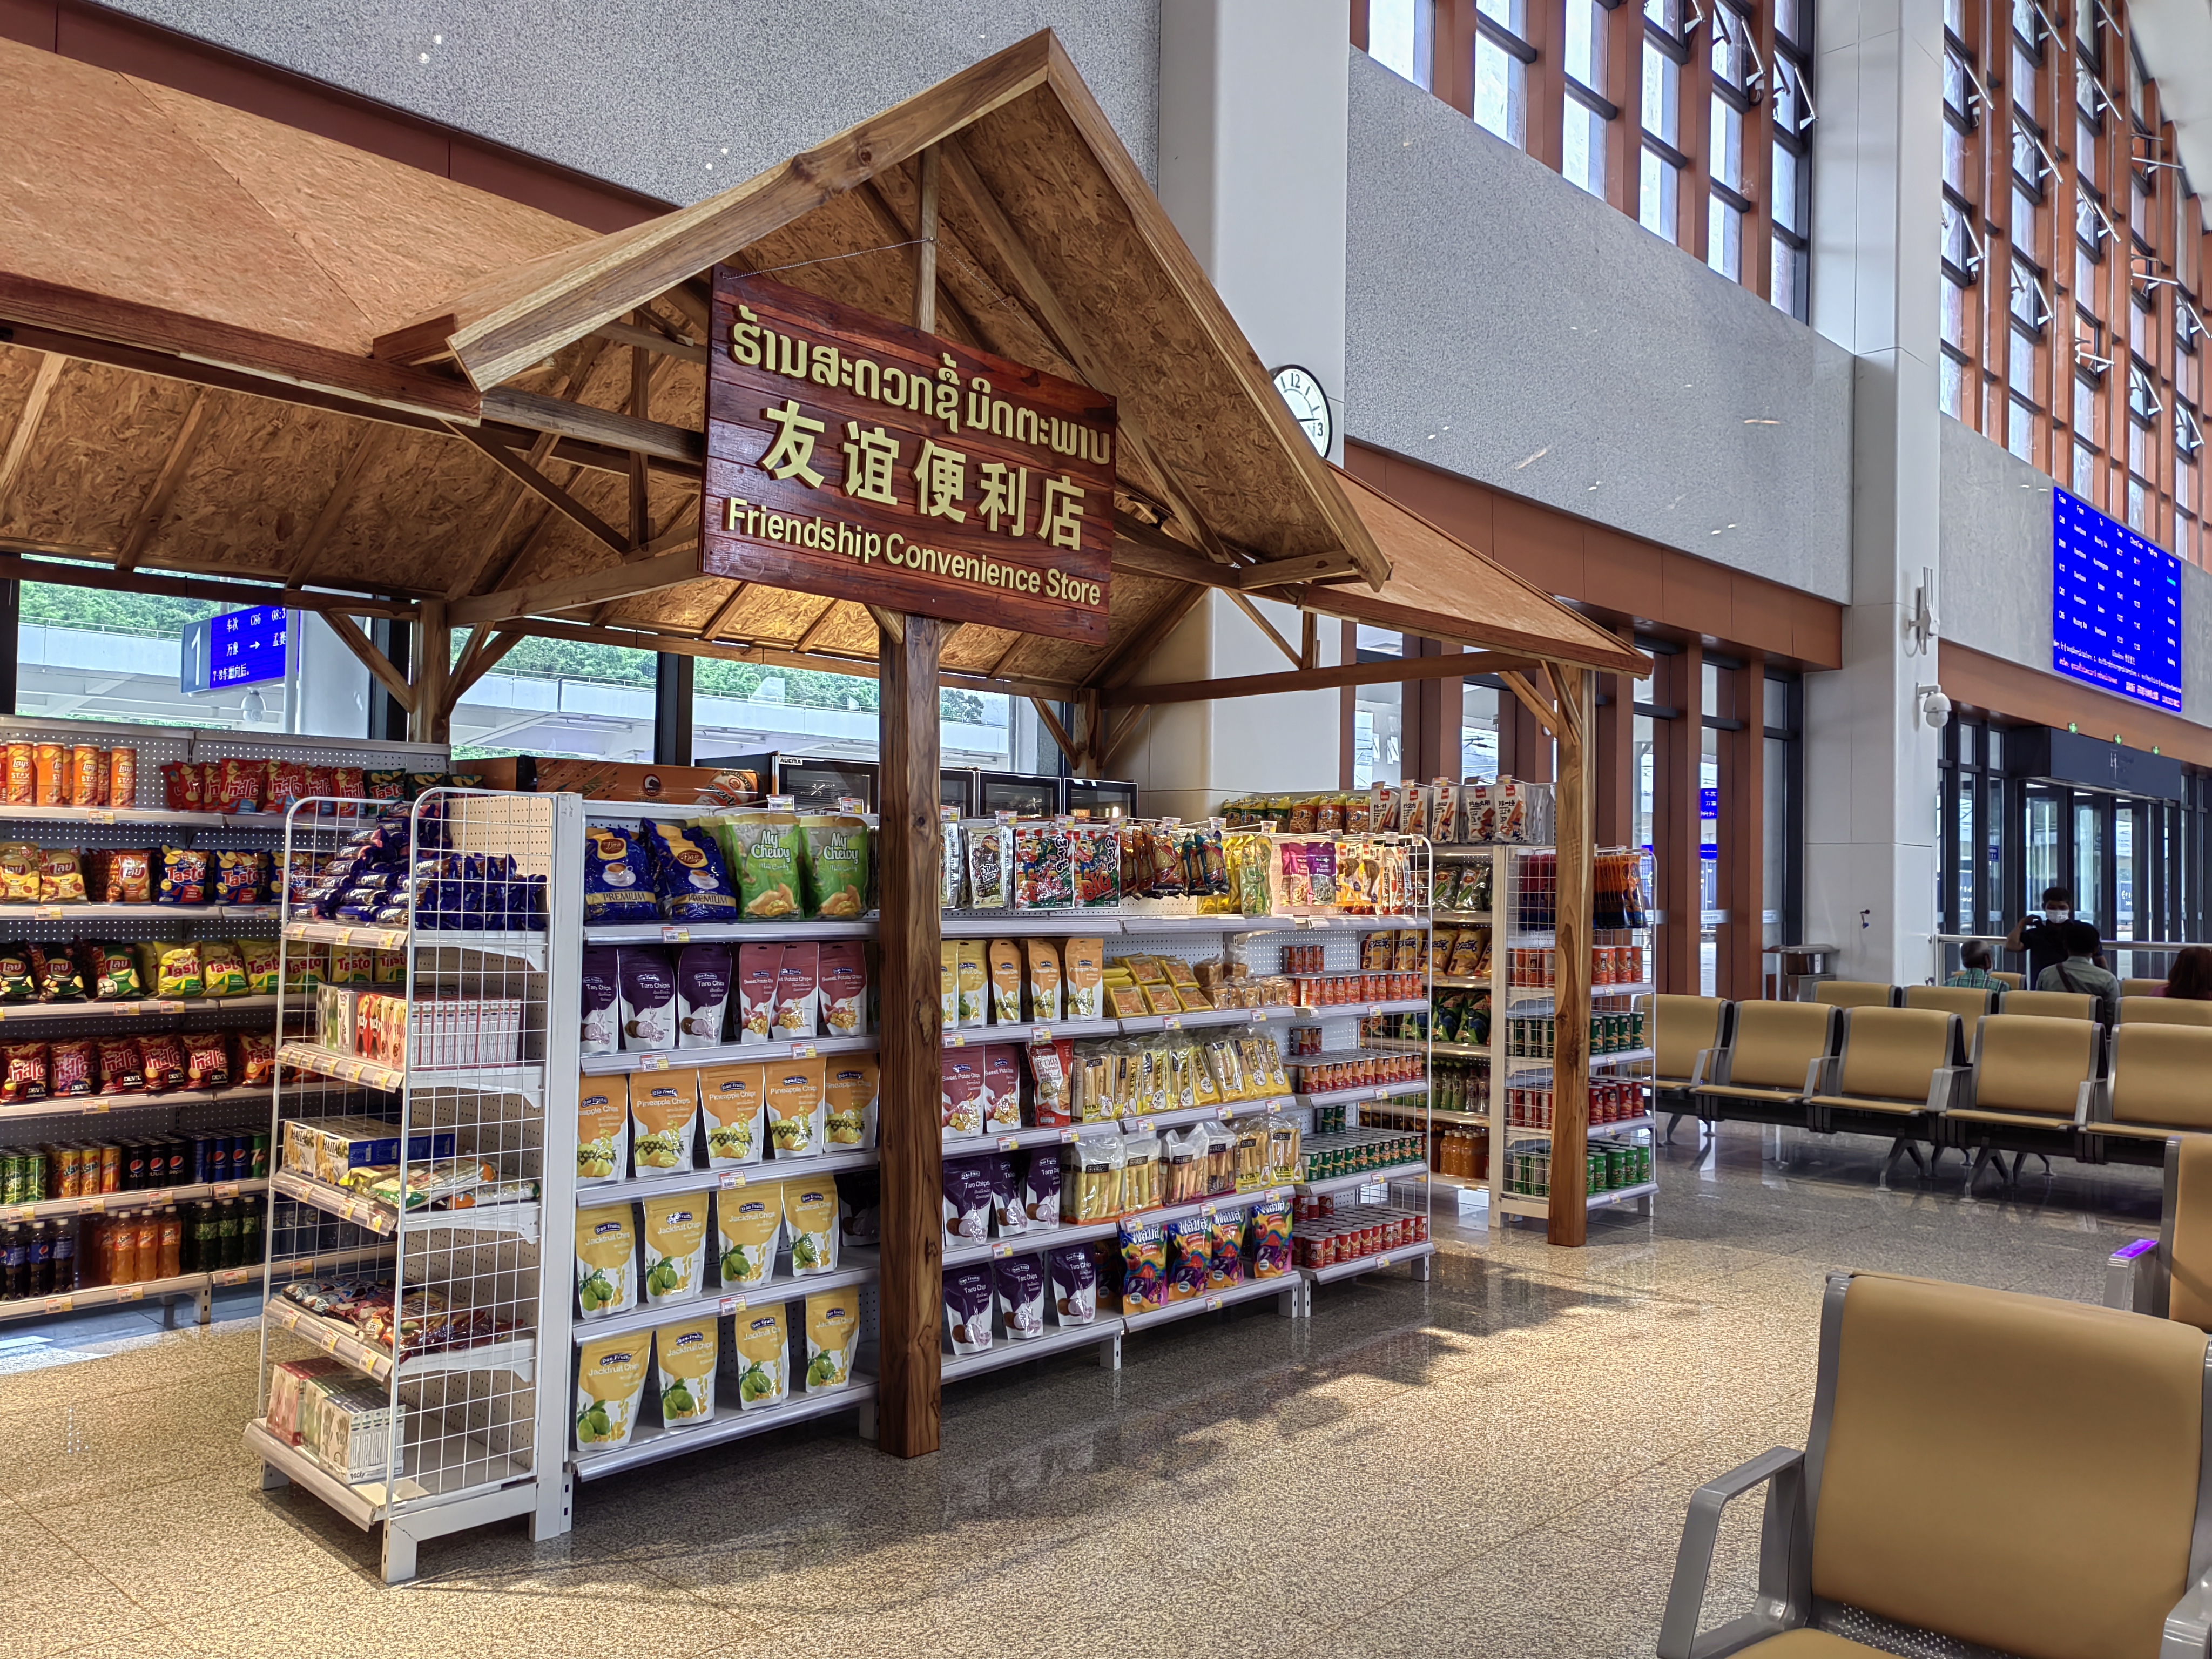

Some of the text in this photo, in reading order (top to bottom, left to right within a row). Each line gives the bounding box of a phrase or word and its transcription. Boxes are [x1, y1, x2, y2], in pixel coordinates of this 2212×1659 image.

[1291, 372, 1300, 389] 12
[1317, 422, 1324, 437] 3
[762, 400, 1085, 550] 友谊便利店
[728, 496, 1101, 605] Friendship Convenience Store
[250, 613, 261, 626] C86
[272, 608, 286, 621] 08:3
[191, 626, 201, 686] 1
[761, 830, 778, 849] My
[832, 832, 848, 851] My
[750, 844, 791, 863] Chewy
[823, 846, 859, 864] Chewy
[416, 860, 434, 872] OREO
[980, 864, 999, 875] EXTRA
[165, 865, 206, 882] Tasto
[361, 874, 380, 885] OREO
[603, 892, 646, 902] PREMIUM
[688, 894, 728, 905] PREMIUM
[381, 908, 402, 919] OREO
[207, 957, 242, 974] Tasto
[337, 957, 371, 972] Tasto
[380, 952, 408, 967] Tast
[709, 1092, 740, 1101] Pineapple
[770, 1086, 802, 1095] Pineapple
[637, 1097, 691, 1108] Pineapple Chips
[975, 1179, 990, 1188] Chips
[729, 1211, 775, 1223] Jackfruit Chips
[657, 1224, 686, 1235] Jackfruit
[585, 1235, 616, 1246] Jackfruit
[743, 1329, 771, 1341] Jackfruit
[667, 1341, 714, 1357] Jackfruit Chips
[588, 1365, 623, 1377] Jackfruit
